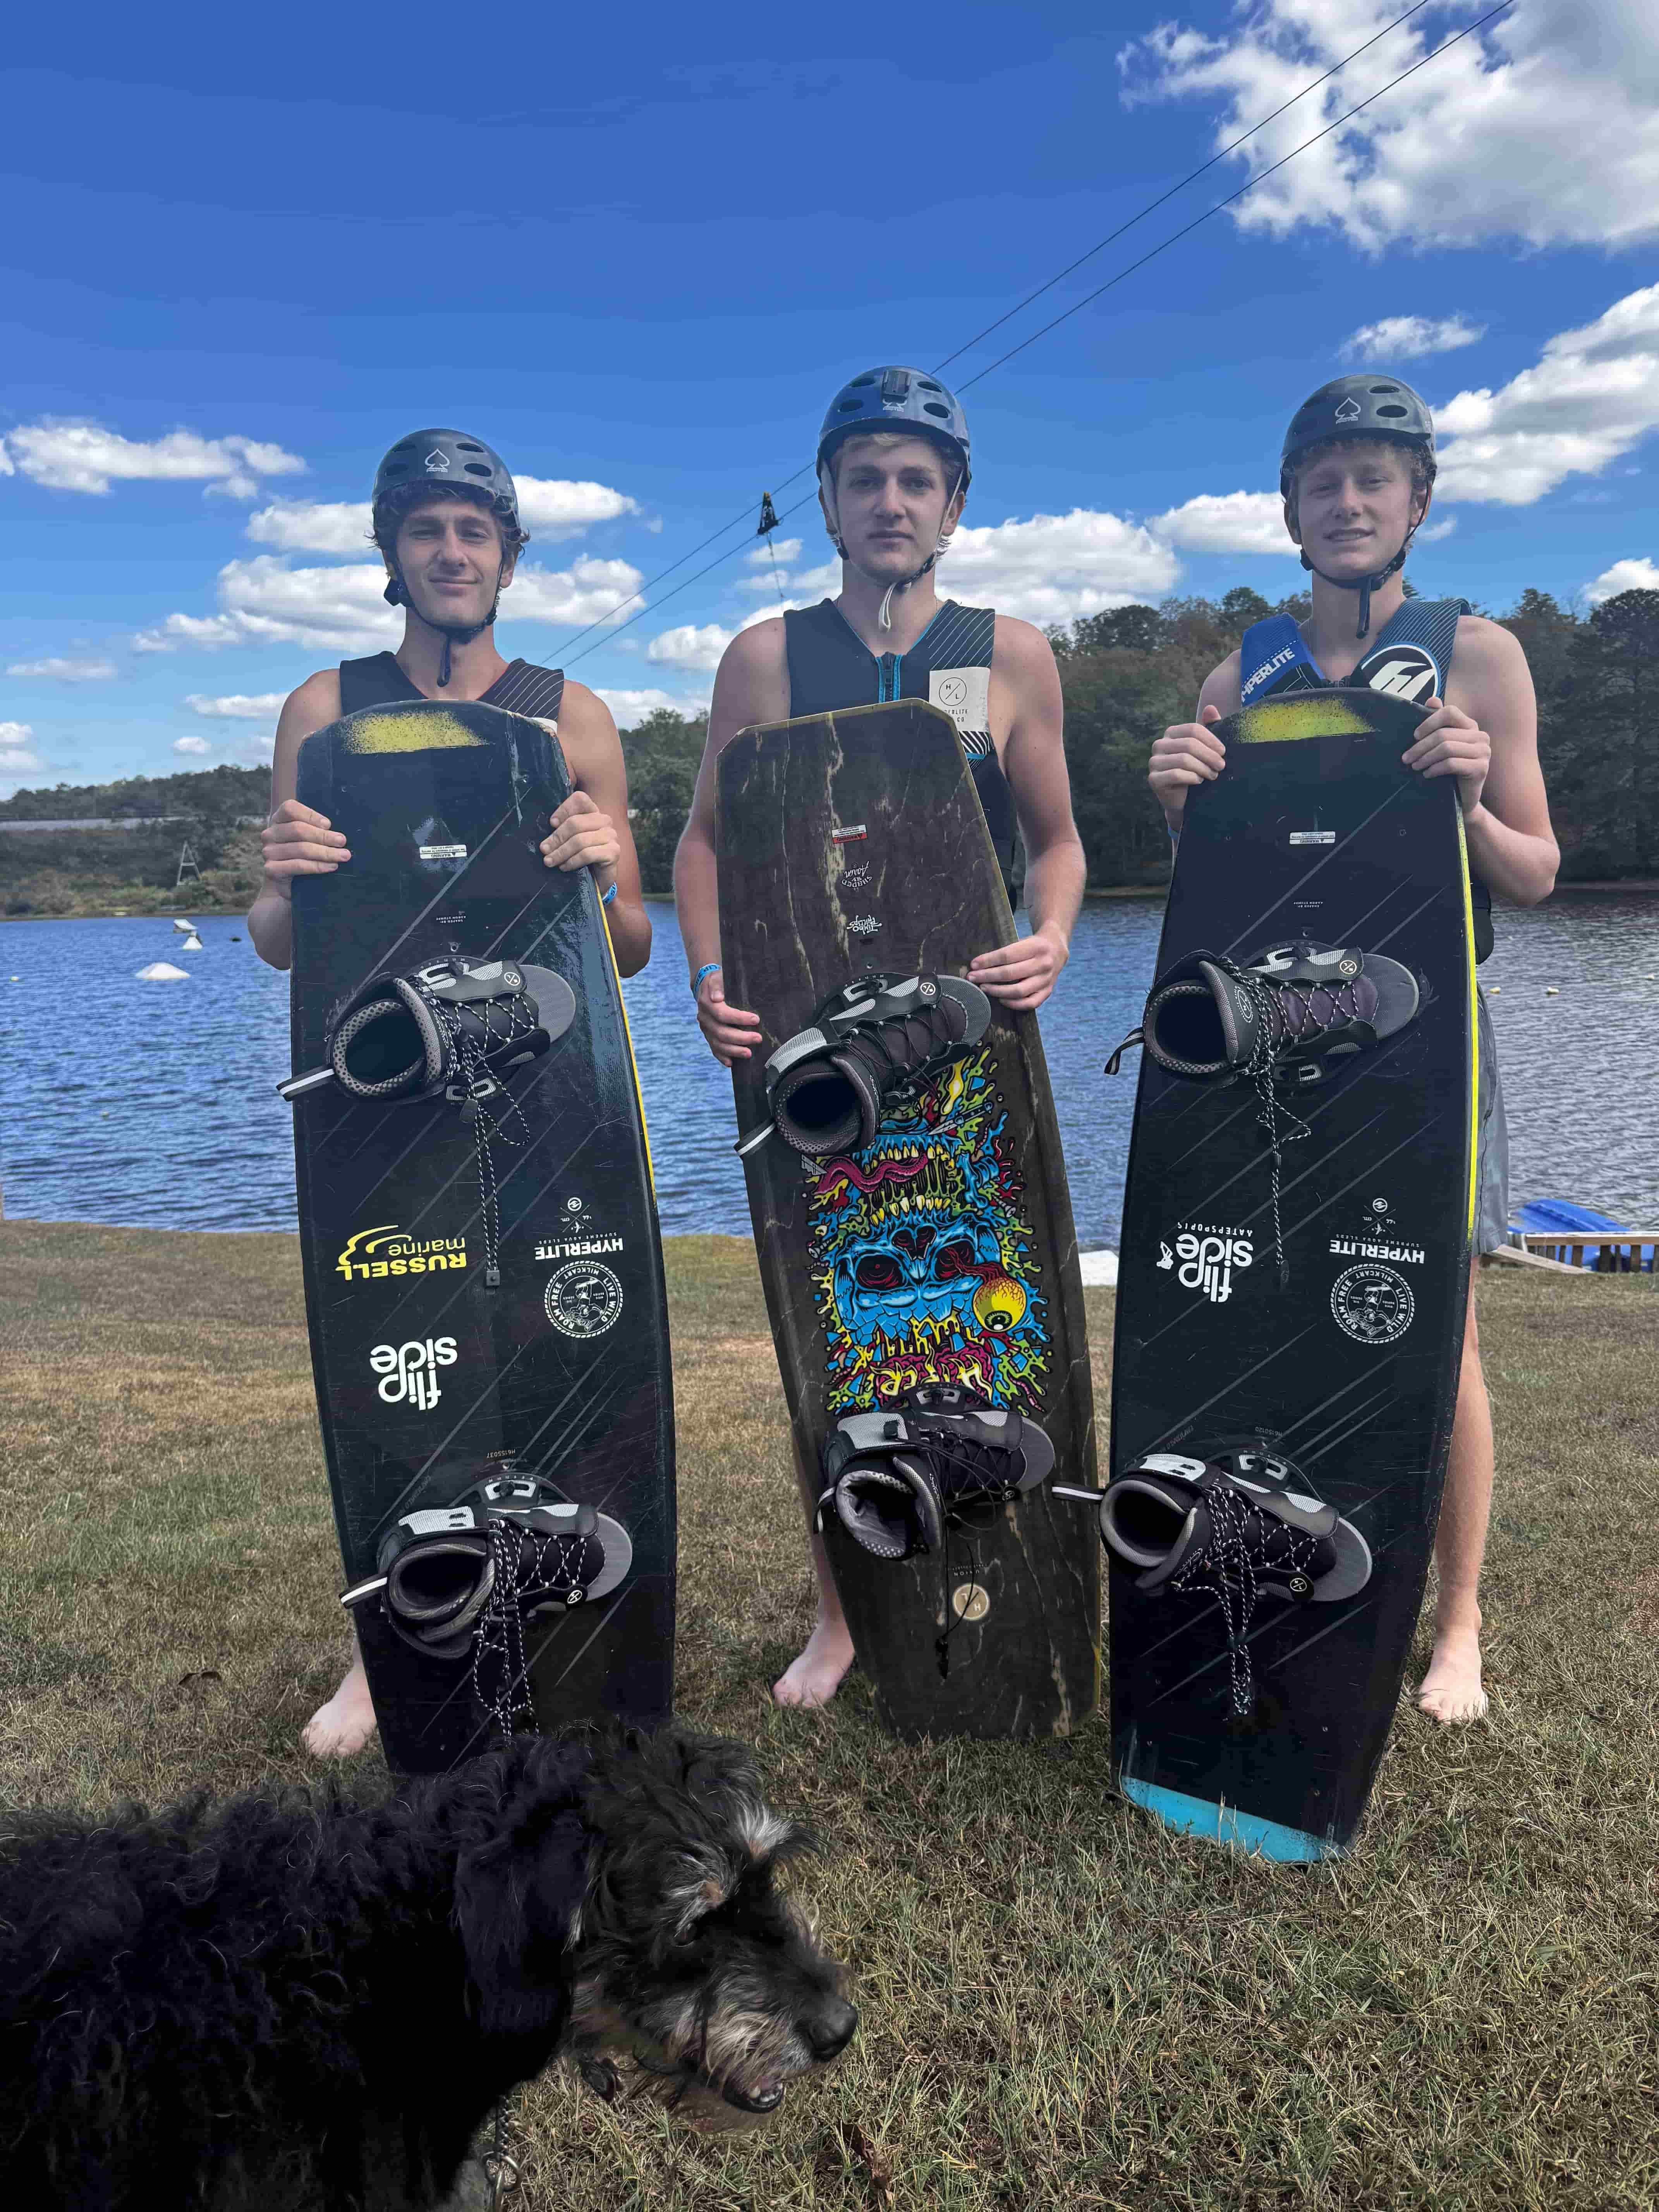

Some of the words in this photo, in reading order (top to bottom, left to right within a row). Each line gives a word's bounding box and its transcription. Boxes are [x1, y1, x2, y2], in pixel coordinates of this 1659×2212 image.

[844, 861, 869, 878] Aaron
[388, 1238, 465, 1257] marine
[534, 1238, 623, 1260] HYPERLITE
[1176, 1234, 1254, 1267] side
[1329, 1240, 1425, 1264] HYPERLITE
[335, 1252, 467, 1280] RUSSELL
[563, 1267, 599, 1279] MILKCART
[1355, 1270, 1394, 1283] MILKCART
[603, 1277, 616, 1298] LIVE
[1178, 1262, 1232, 1302] flip
[1338, 1279, 1352, 1302] FREE
[551, 1282, 562, 1306] FREE
[1395, 1288, 1407, 1309] LIVE
[554, 1308, 574, 1329] ROAM
[601, 1301, 616, 1322] WILD
[1338, 1306, 1358, 1330] ROAM
[1387, 1313, 1406, 1333] WILD
[370, 1336, 458, 1374] side
[378, 1360, 442, 1411] flip
[486, 1449, 515, 1458] H6155037
